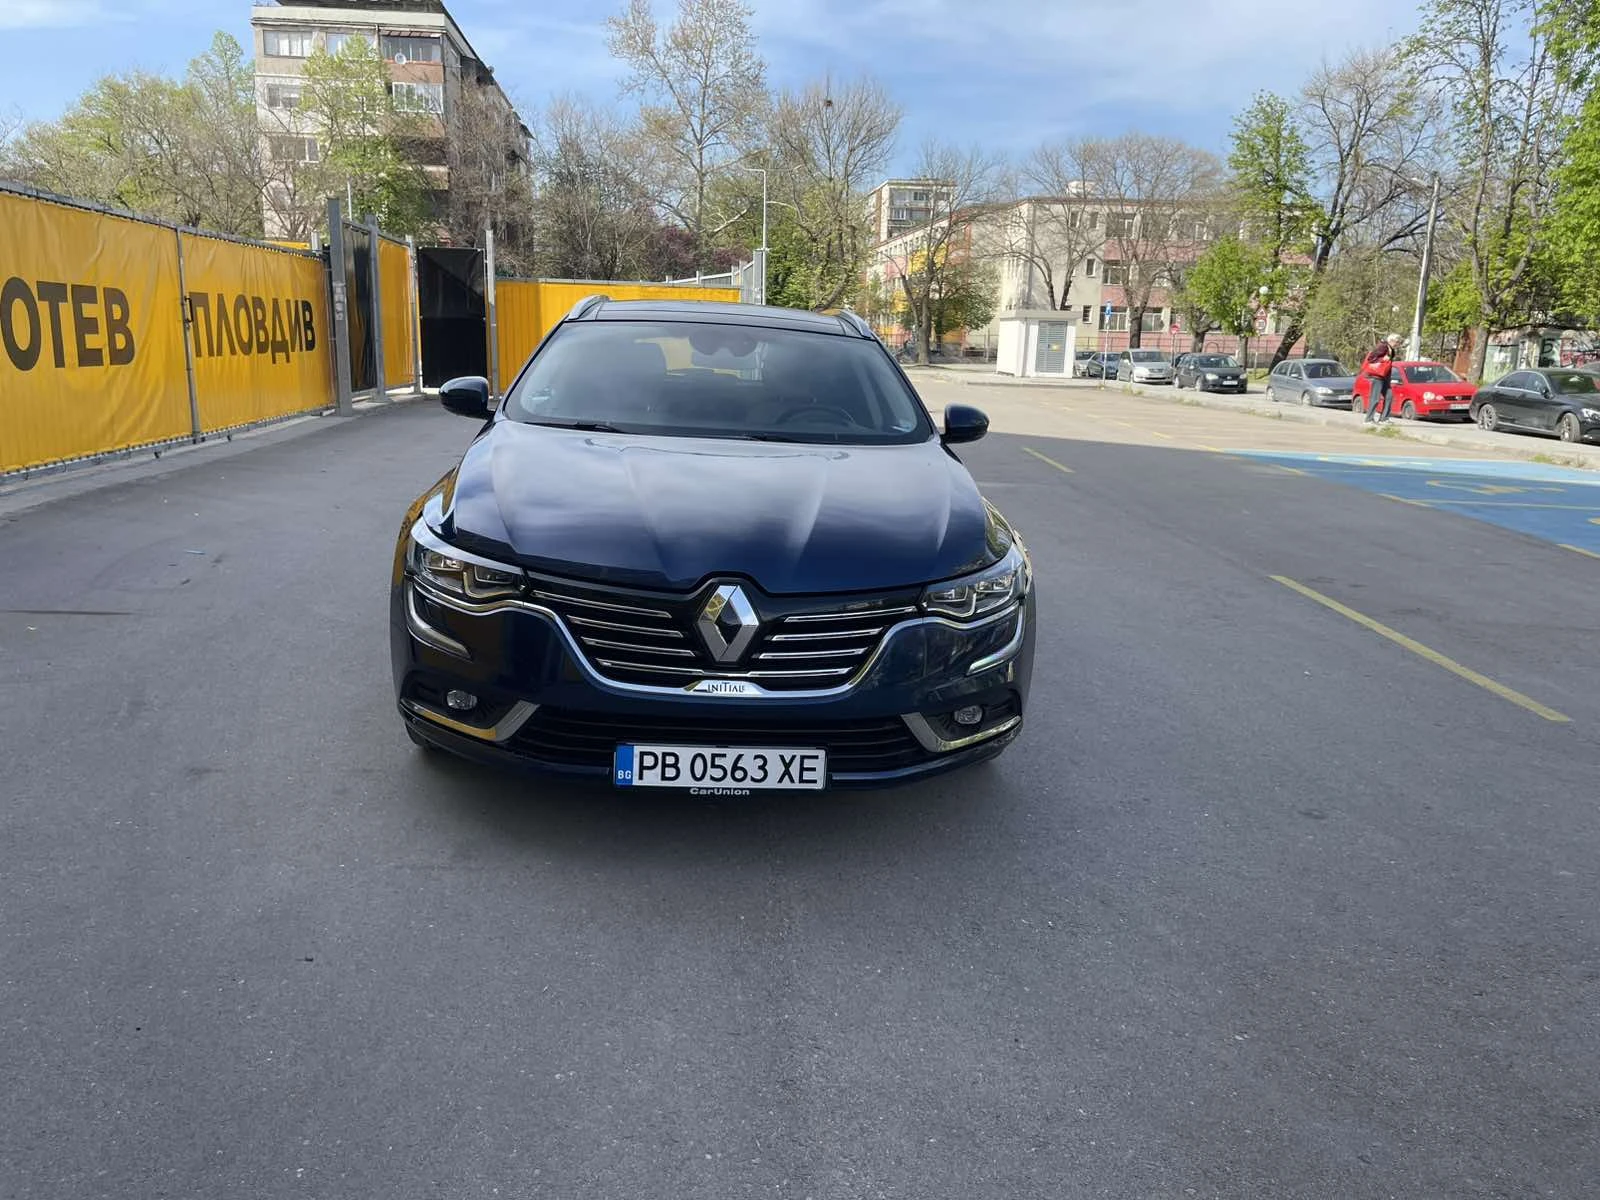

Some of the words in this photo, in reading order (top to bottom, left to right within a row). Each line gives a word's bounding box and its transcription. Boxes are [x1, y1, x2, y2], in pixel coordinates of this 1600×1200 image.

[0, 276, 136, 371] ОТЕВ
[188, 291, 316, 364] ПЛОВДИВ
[617, 769, 632, 780] BG
[638, 751, 681, 782] PB
[690, 752, 769, 783] 0563
[777, 754, 819, 784] XE
[690, 787, 750, 796] CarUnion
